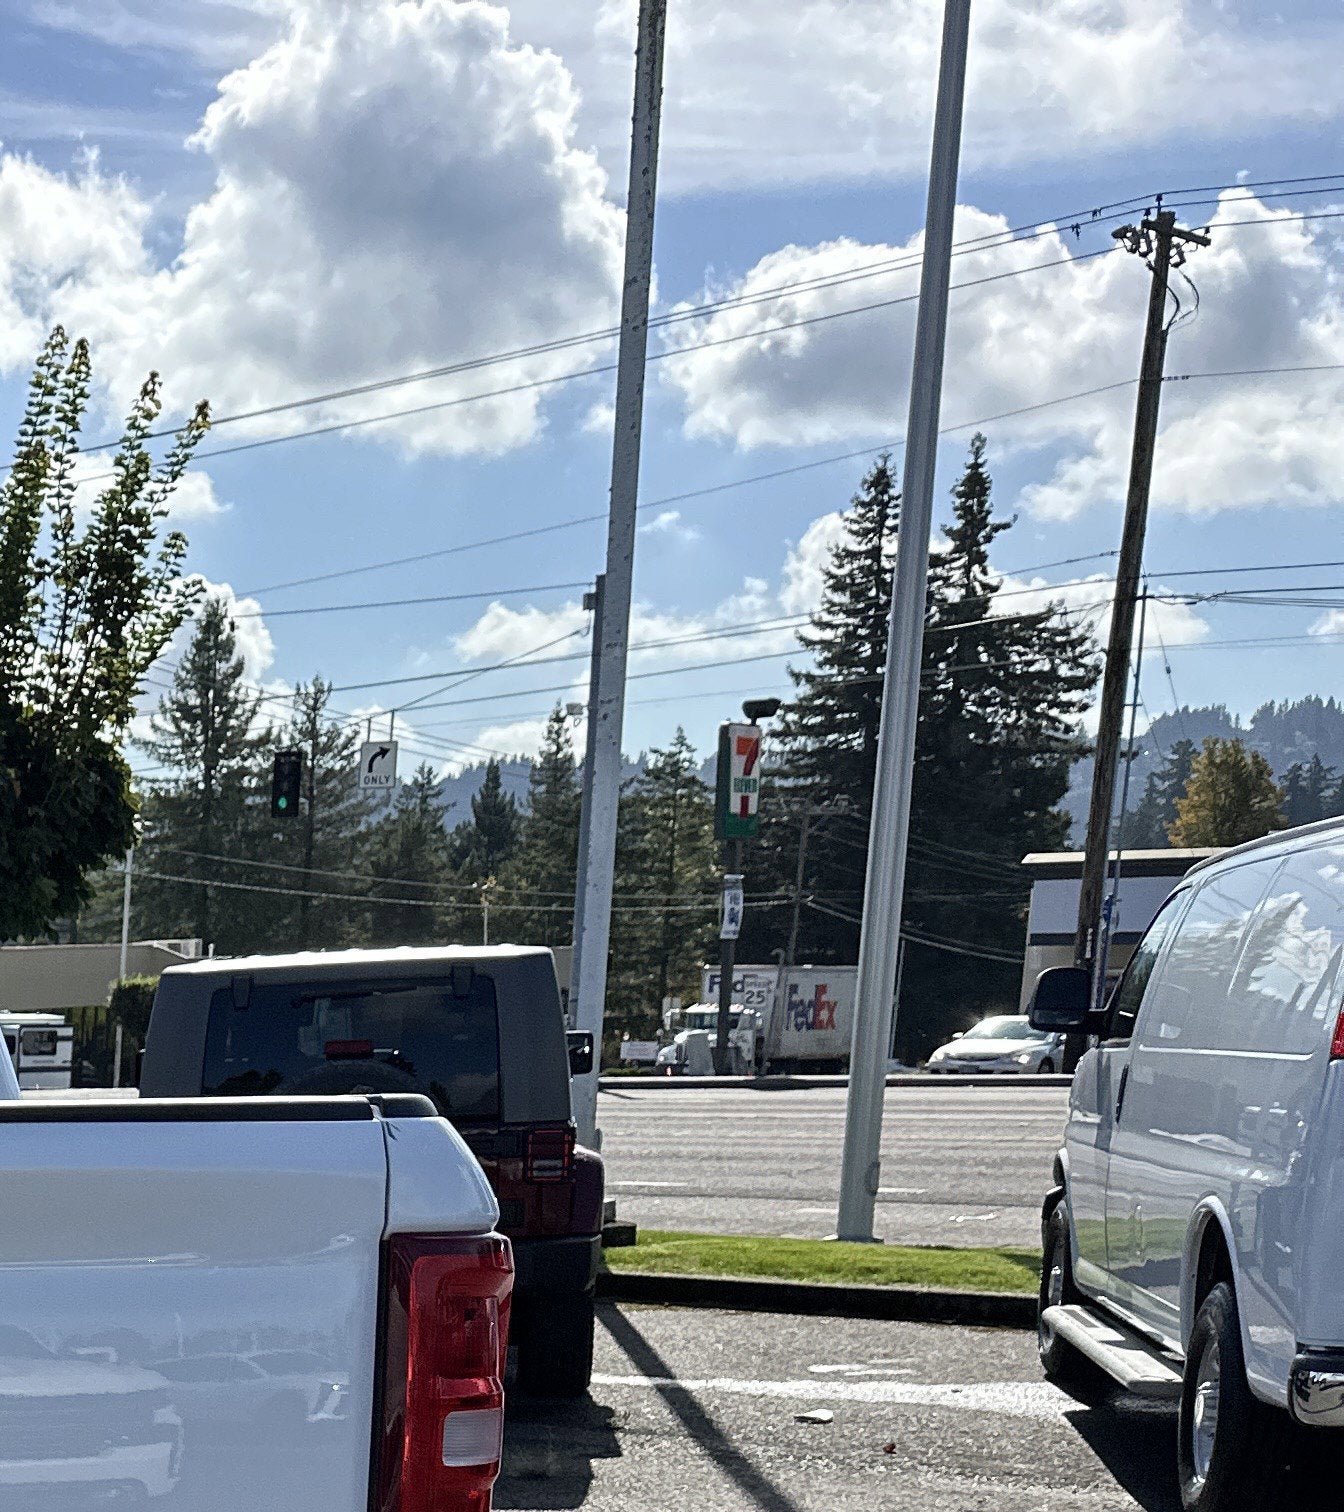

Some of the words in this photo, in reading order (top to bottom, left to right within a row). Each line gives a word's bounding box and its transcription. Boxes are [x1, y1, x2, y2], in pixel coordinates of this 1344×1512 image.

[735, 735, 759, 776] 7
[363, 774, 391, 785] ONLY
[745, 990, 766, 1005] 25
[785, 983, 839, 1032] FedEx
